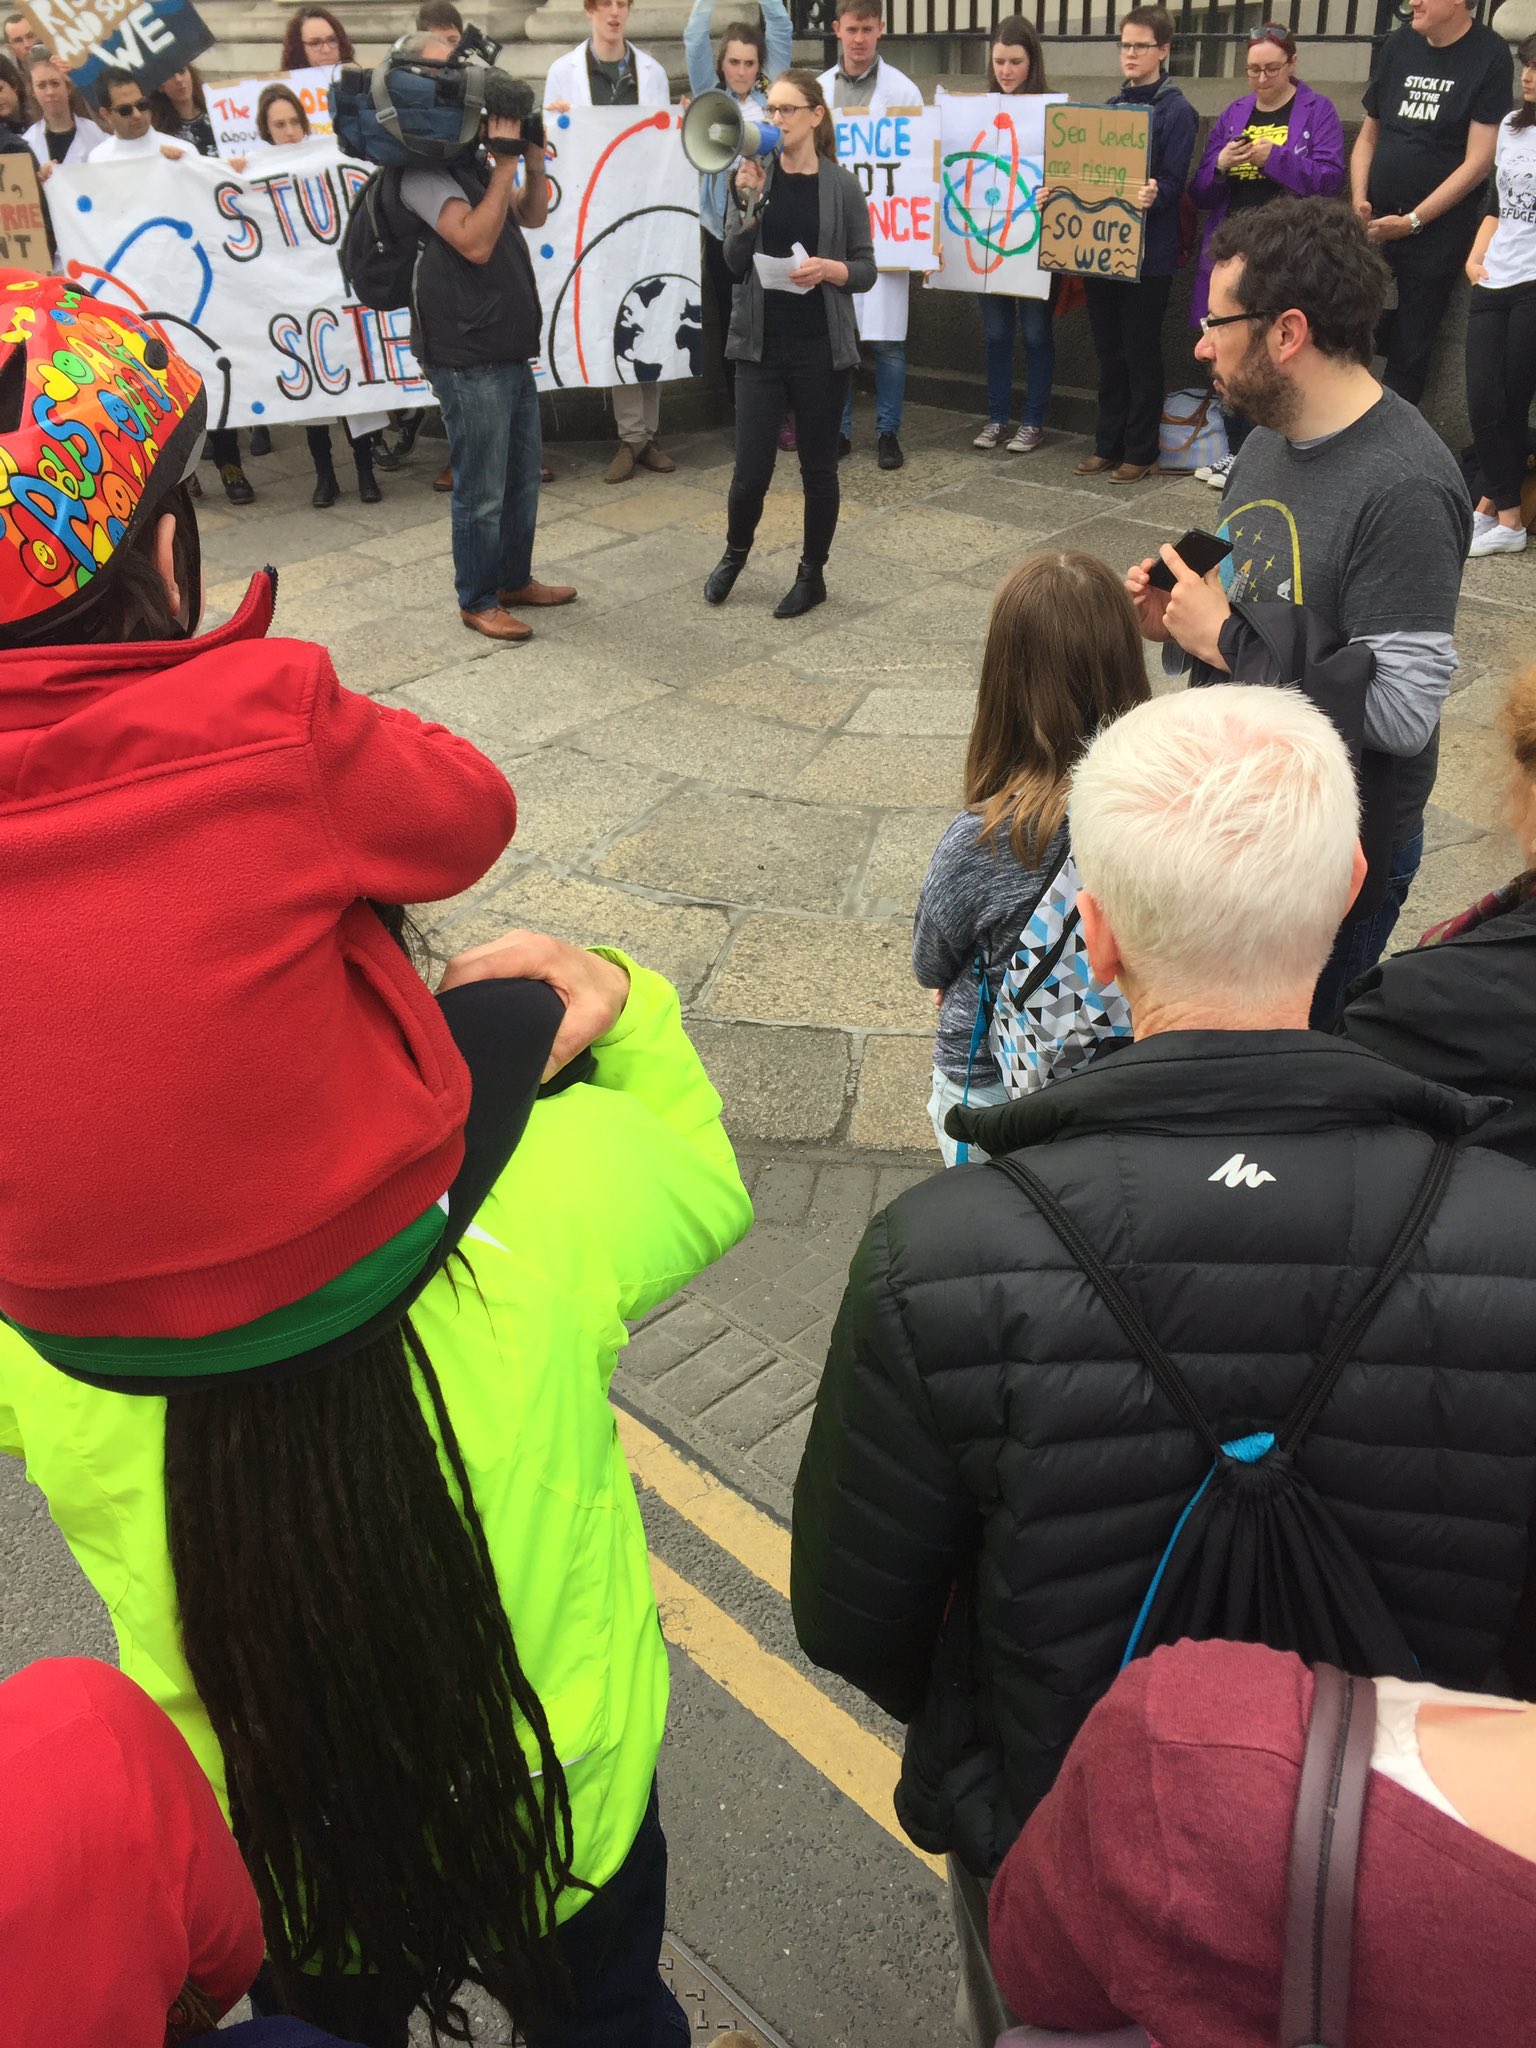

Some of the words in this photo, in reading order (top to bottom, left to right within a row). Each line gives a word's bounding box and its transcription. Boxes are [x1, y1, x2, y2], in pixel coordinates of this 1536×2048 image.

[87, 2, 176, 72] WE
[1404, 75, 1440, 91] STICK
[1439, 79, 1455, 92] IT
[1409, 90, 1421, 101] TO
[1422, 91, 1440, 103] THE
[213, 97, 250, 121] The
[1398, 100, 1440, 121] MAN
[835, 116, 911, 158] ENCE
[1052, 112, 1086, 148] Sea
[842, 162, 901, 197] OT
[1082, 160, 1128, 198] rising
[214, 163, 382, 263] STUD
[868, 196, 932, 242] NCE
[1500, 207, 1536, 225] EFUGE
[1093, 219, 1132, 244] are
[1074, 244, 1113, 272] we
[267, 303, 430, 402] SCIE
[8, 393, 103, 574] ABUS
